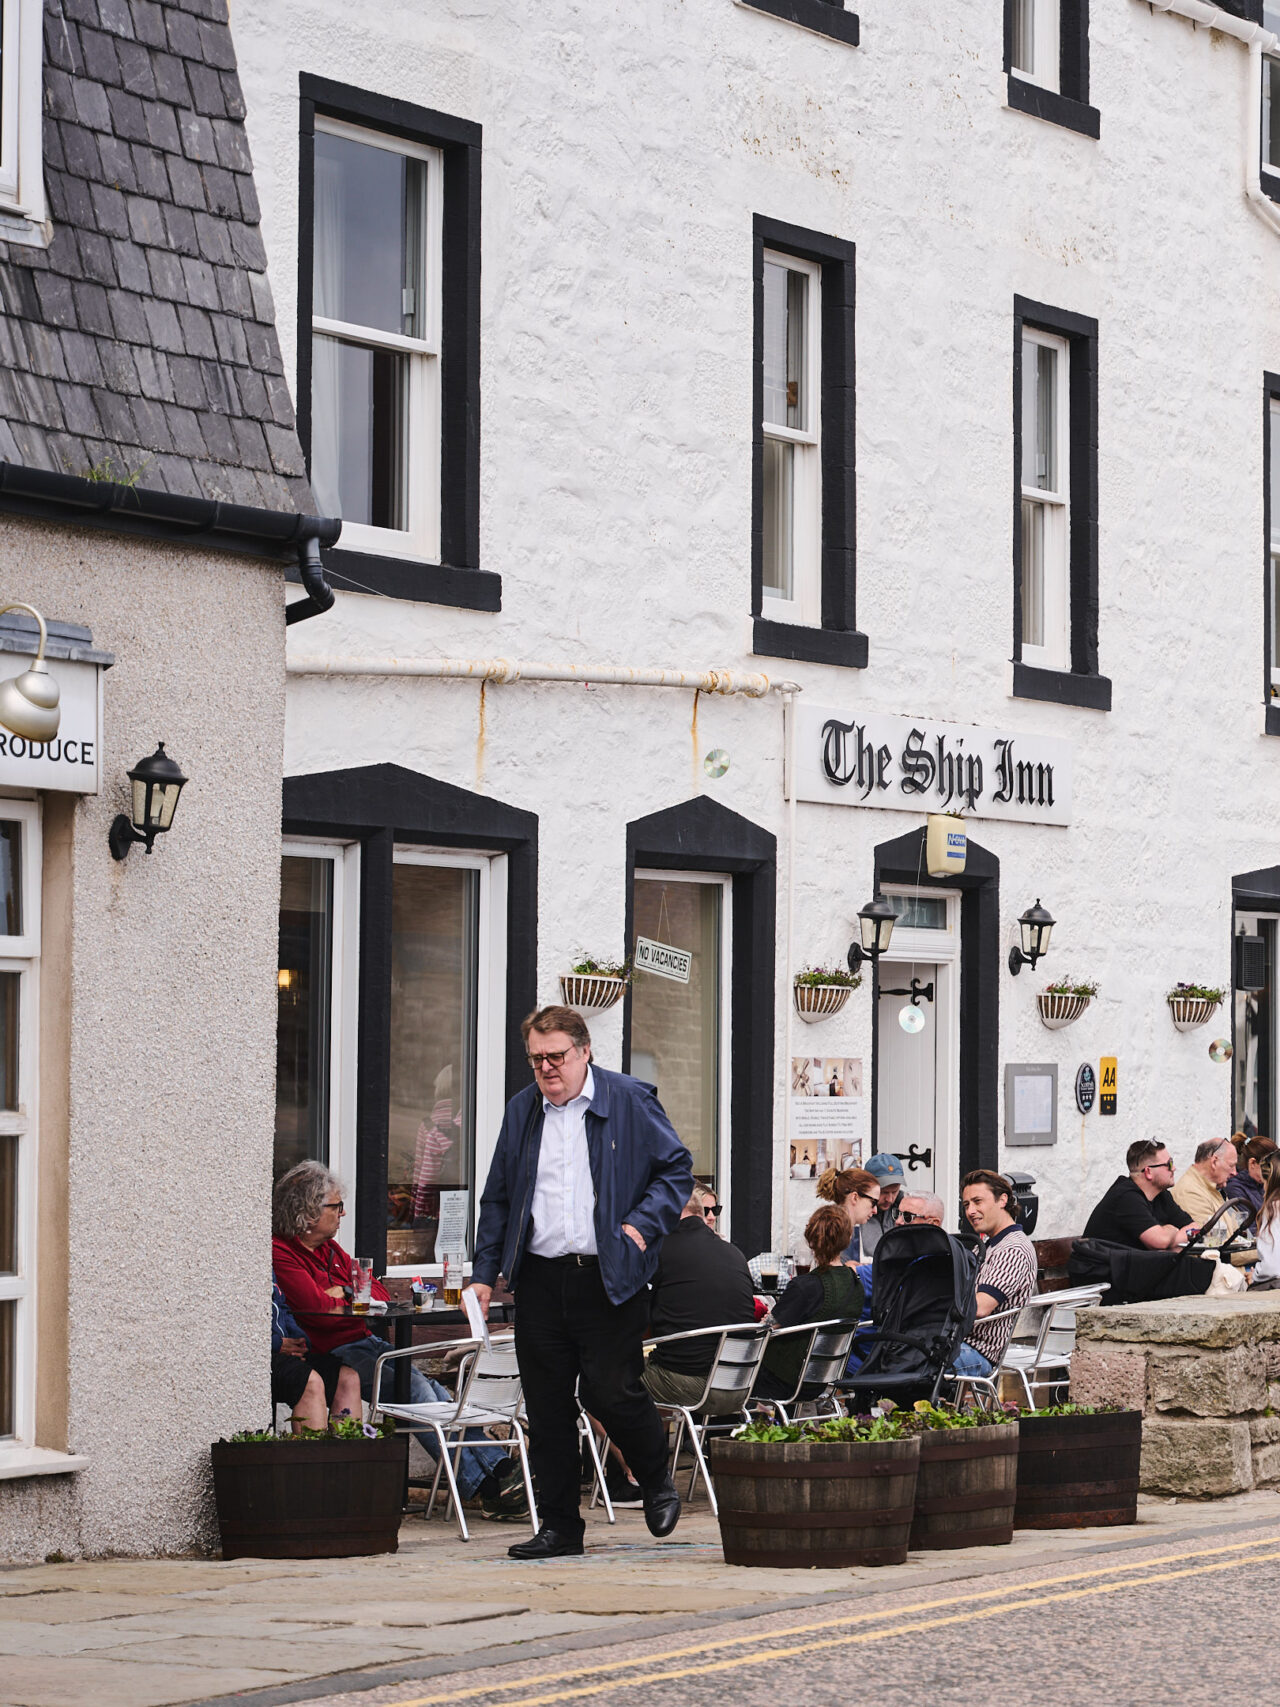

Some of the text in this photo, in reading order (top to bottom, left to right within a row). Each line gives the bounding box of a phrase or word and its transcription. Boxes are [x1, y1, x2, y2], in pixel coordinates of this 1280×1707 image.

[821, 719, 1056, 812] The Ship Inn
[638, 945, 650, 960] NO
[651, 948, 688, 973] VACANCIES
[1102, 1067, 1116, 1087] AA
